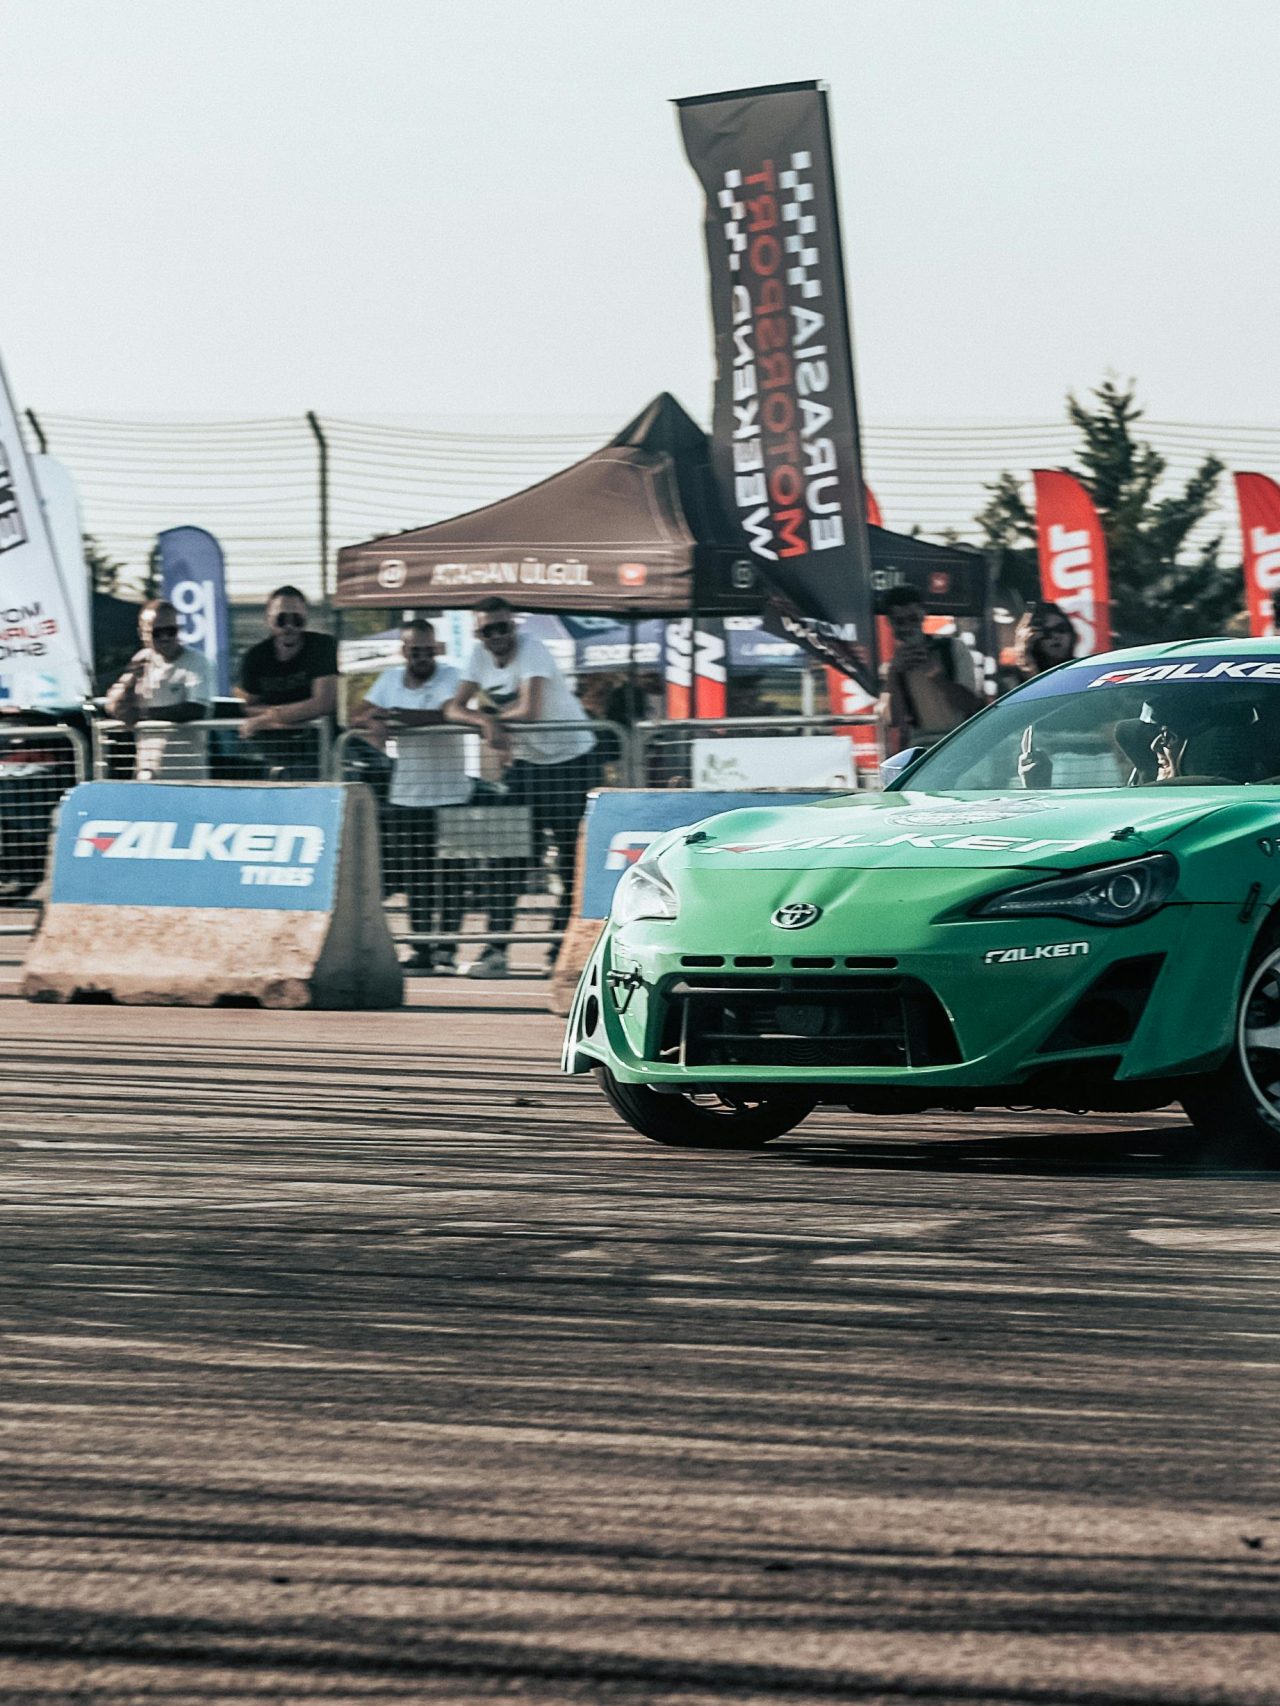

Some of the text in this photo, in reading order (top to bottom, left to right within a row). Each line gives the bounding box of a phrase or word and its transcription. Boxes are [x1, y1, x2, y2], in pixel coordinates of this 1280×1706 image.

[71, 819, 328, 865] FALKEN
[696, 832, 1097, 855] FALKEN
[239, 864, 316, 888] TYRES
[983, 941, 1089, 965] FALKEN
